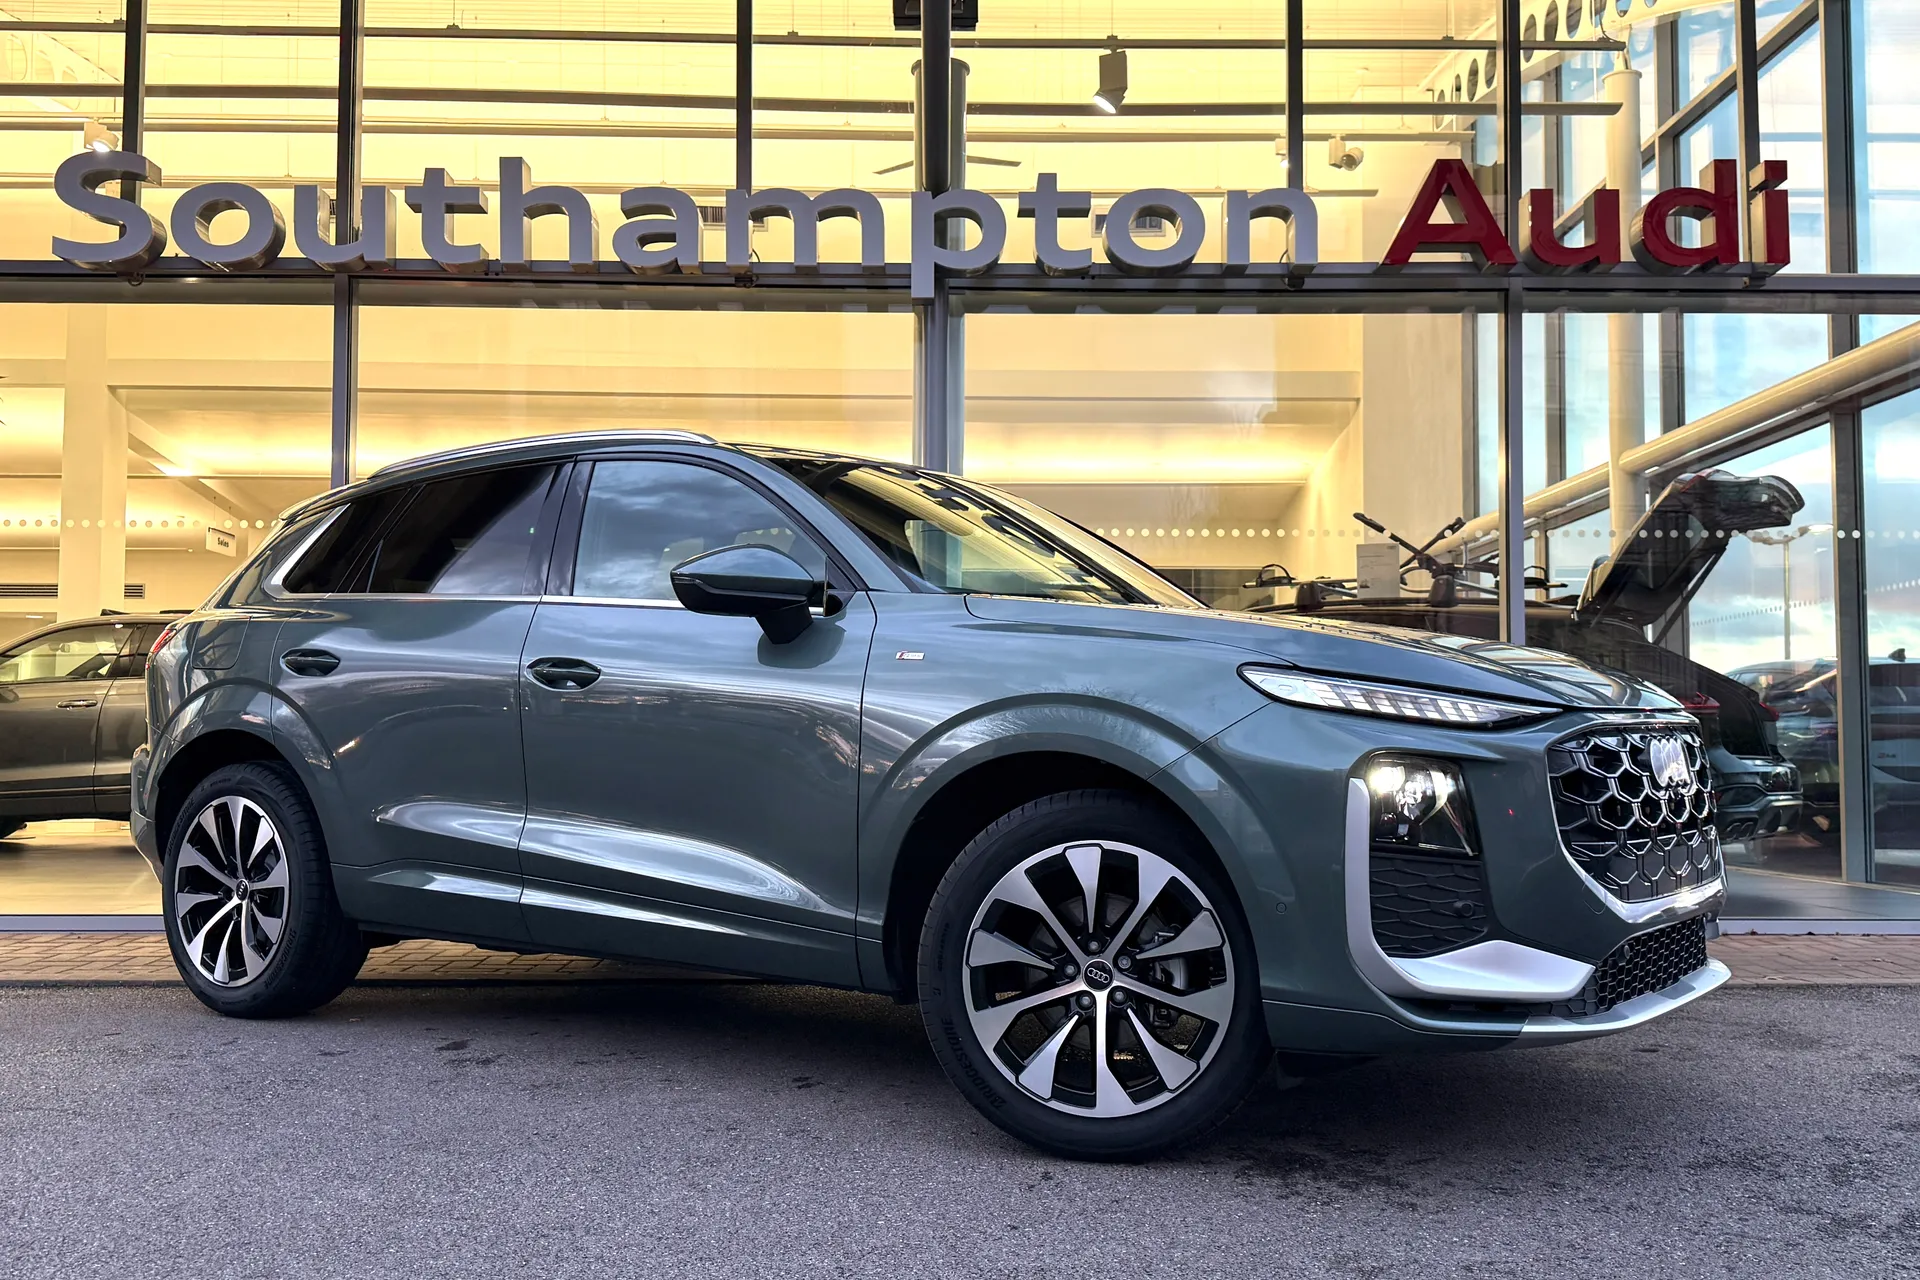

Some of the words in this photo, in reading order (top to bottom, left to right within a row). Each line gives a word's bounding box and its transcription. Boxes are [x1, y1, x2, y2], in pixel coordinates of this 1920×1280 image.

[52, 151, 1318, 301] Southampton
[1384, 158, 1790, 274] Audi
[217, 537, 230, 548] Sales
[941, 1015, 1007, 1109] BRIDGESTONE
